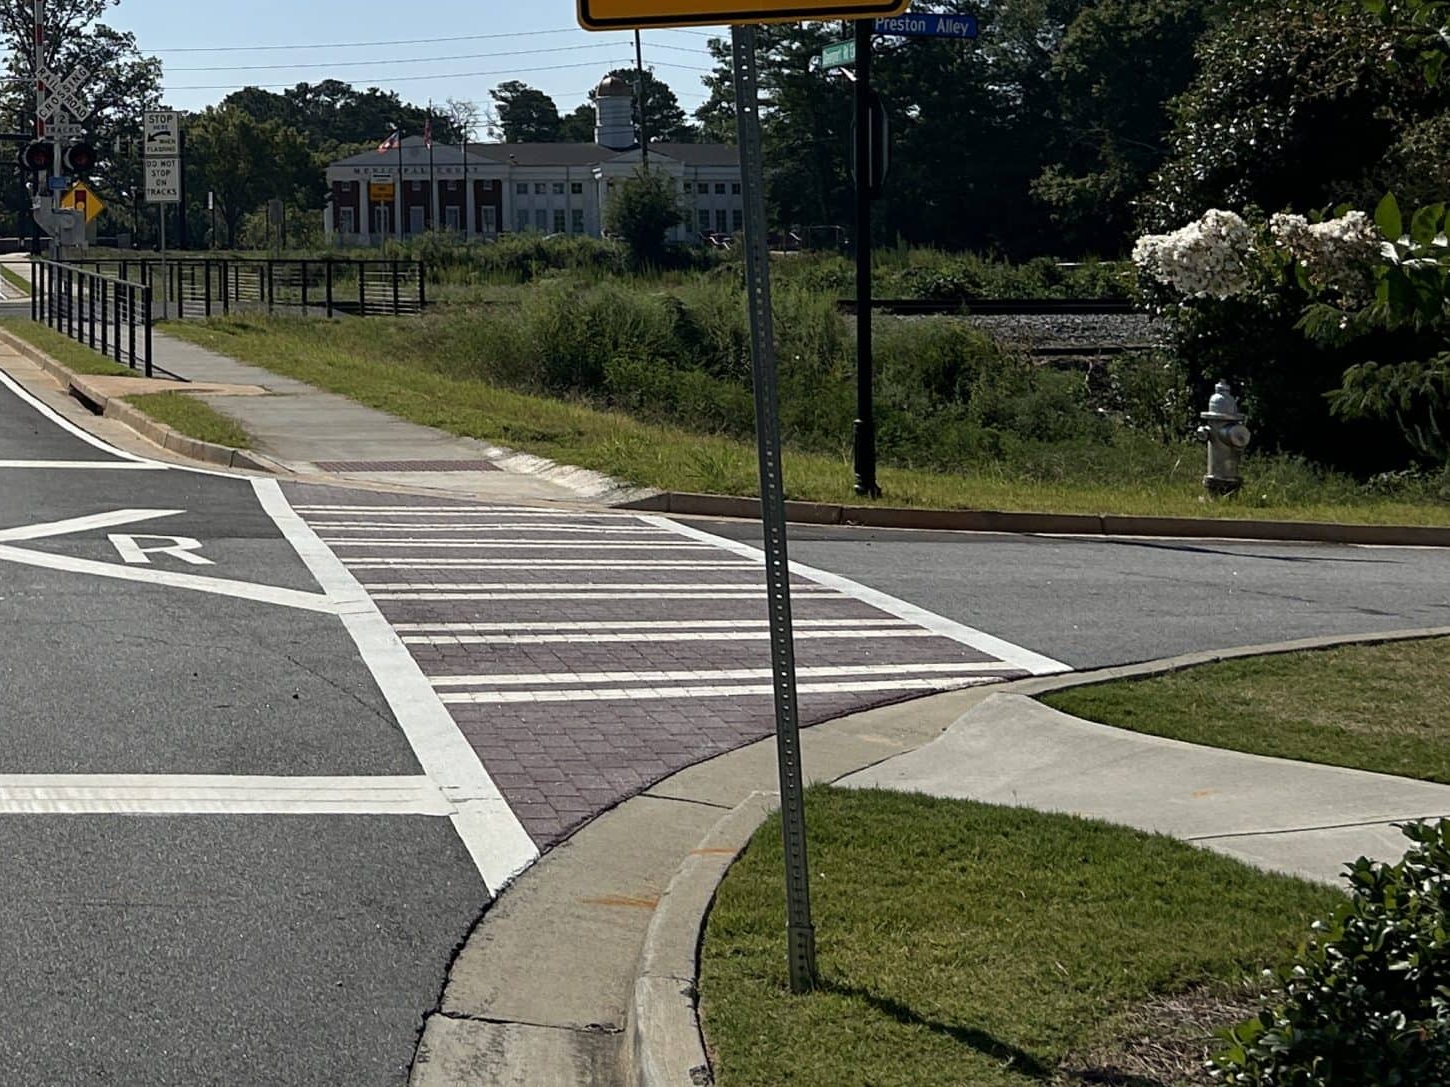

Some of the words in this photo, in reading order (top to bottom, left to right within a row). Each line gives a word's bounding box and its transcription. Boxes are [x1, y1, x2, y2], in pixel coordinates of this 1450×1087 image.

[875, 17, 926, 32] Preston
[936, 17, 969, 36] Alley
[37, 68, 87, 118] RAILROAD
[38, 68, 87, 118] CROSSING
[58, 114, 65, 124] 2
[149, 114, 173, 124] STOP
[147, 160, 157, 168] DO
[160, 160, 175, 168] NOT
[151, 169, 171, 177] STOP
[147, 188, 177, 196] TRACKS
[106, 532, 215, 565] R
